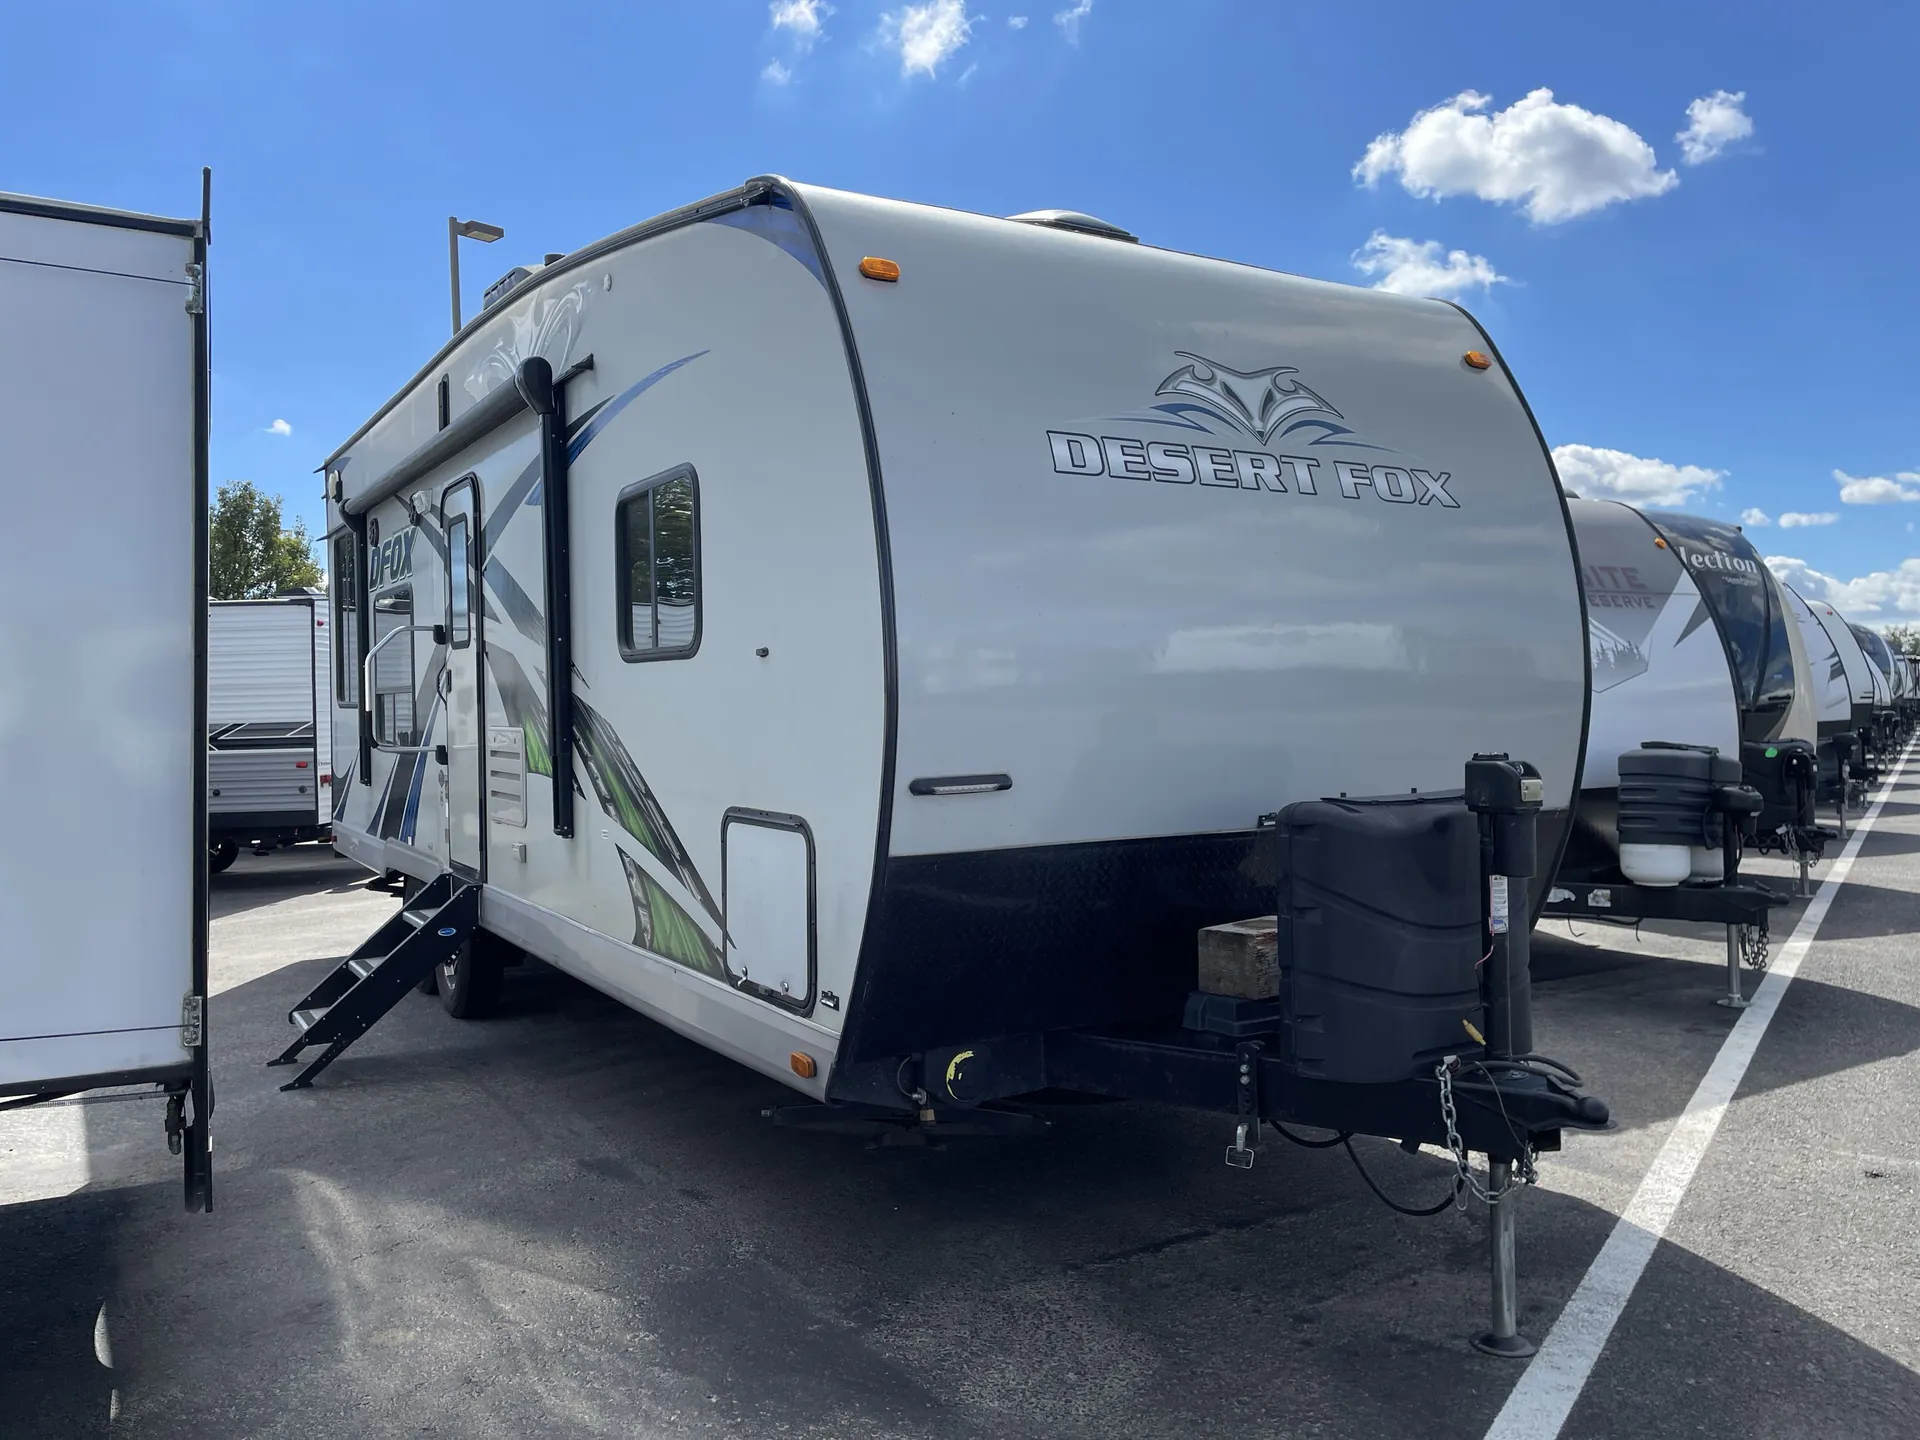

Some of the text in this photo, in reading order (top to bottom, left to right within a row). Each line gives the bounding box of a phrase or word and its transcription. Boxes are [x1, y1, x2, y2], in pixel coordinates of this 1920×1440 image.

[1046, 430, 1461, 508] DESERT FOX
[369, 525, 418, 592] DFOX
[1676, 546, 1758, 574] lection
[1587, 593, 1656, 609] ESERVE
